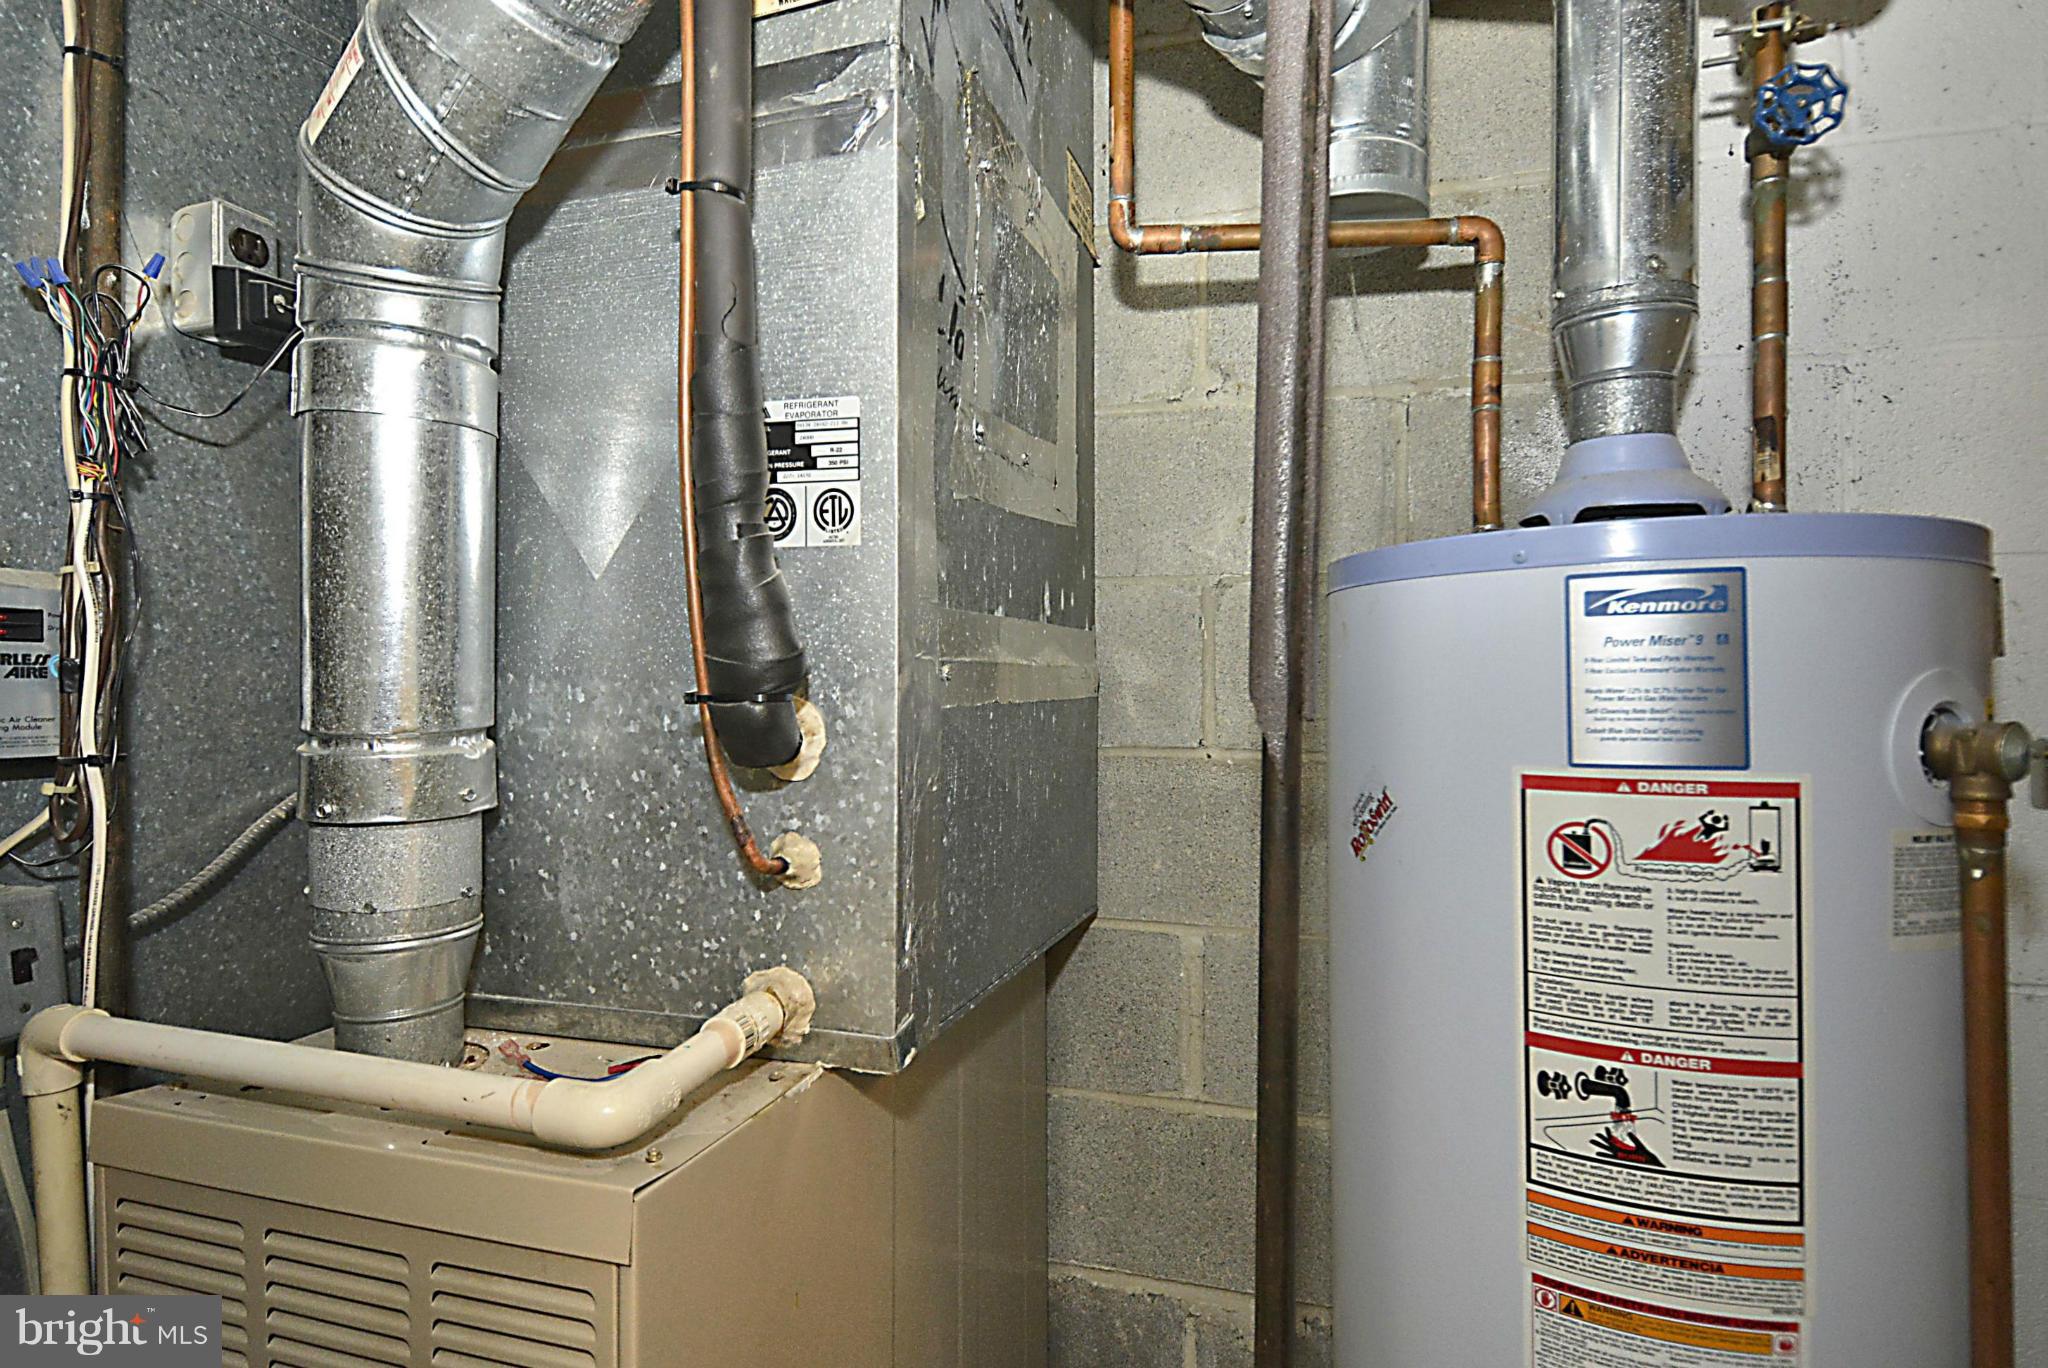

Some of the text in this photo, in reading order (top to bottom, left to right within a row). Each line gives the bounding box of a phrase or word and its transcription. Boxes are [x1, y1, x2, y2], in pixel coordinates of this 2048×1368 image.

[784, 400, 838, 409] REFRIGERANT
[785, 410, 838, 419] EVAPORATOR
[1606, 600, 1725, 614] Kenmore
[1604, 636, 1646, 648] Power
[4, 667, 48, 679] AIRE
[1637, 782, 1708, 794] DANGER
[1640, 1053, 1712, 1070] DANGER
[1636, 1216, 1702, 1236] WARNING
[1621, 1246, 1724, 1274] ADVERTENCIA
